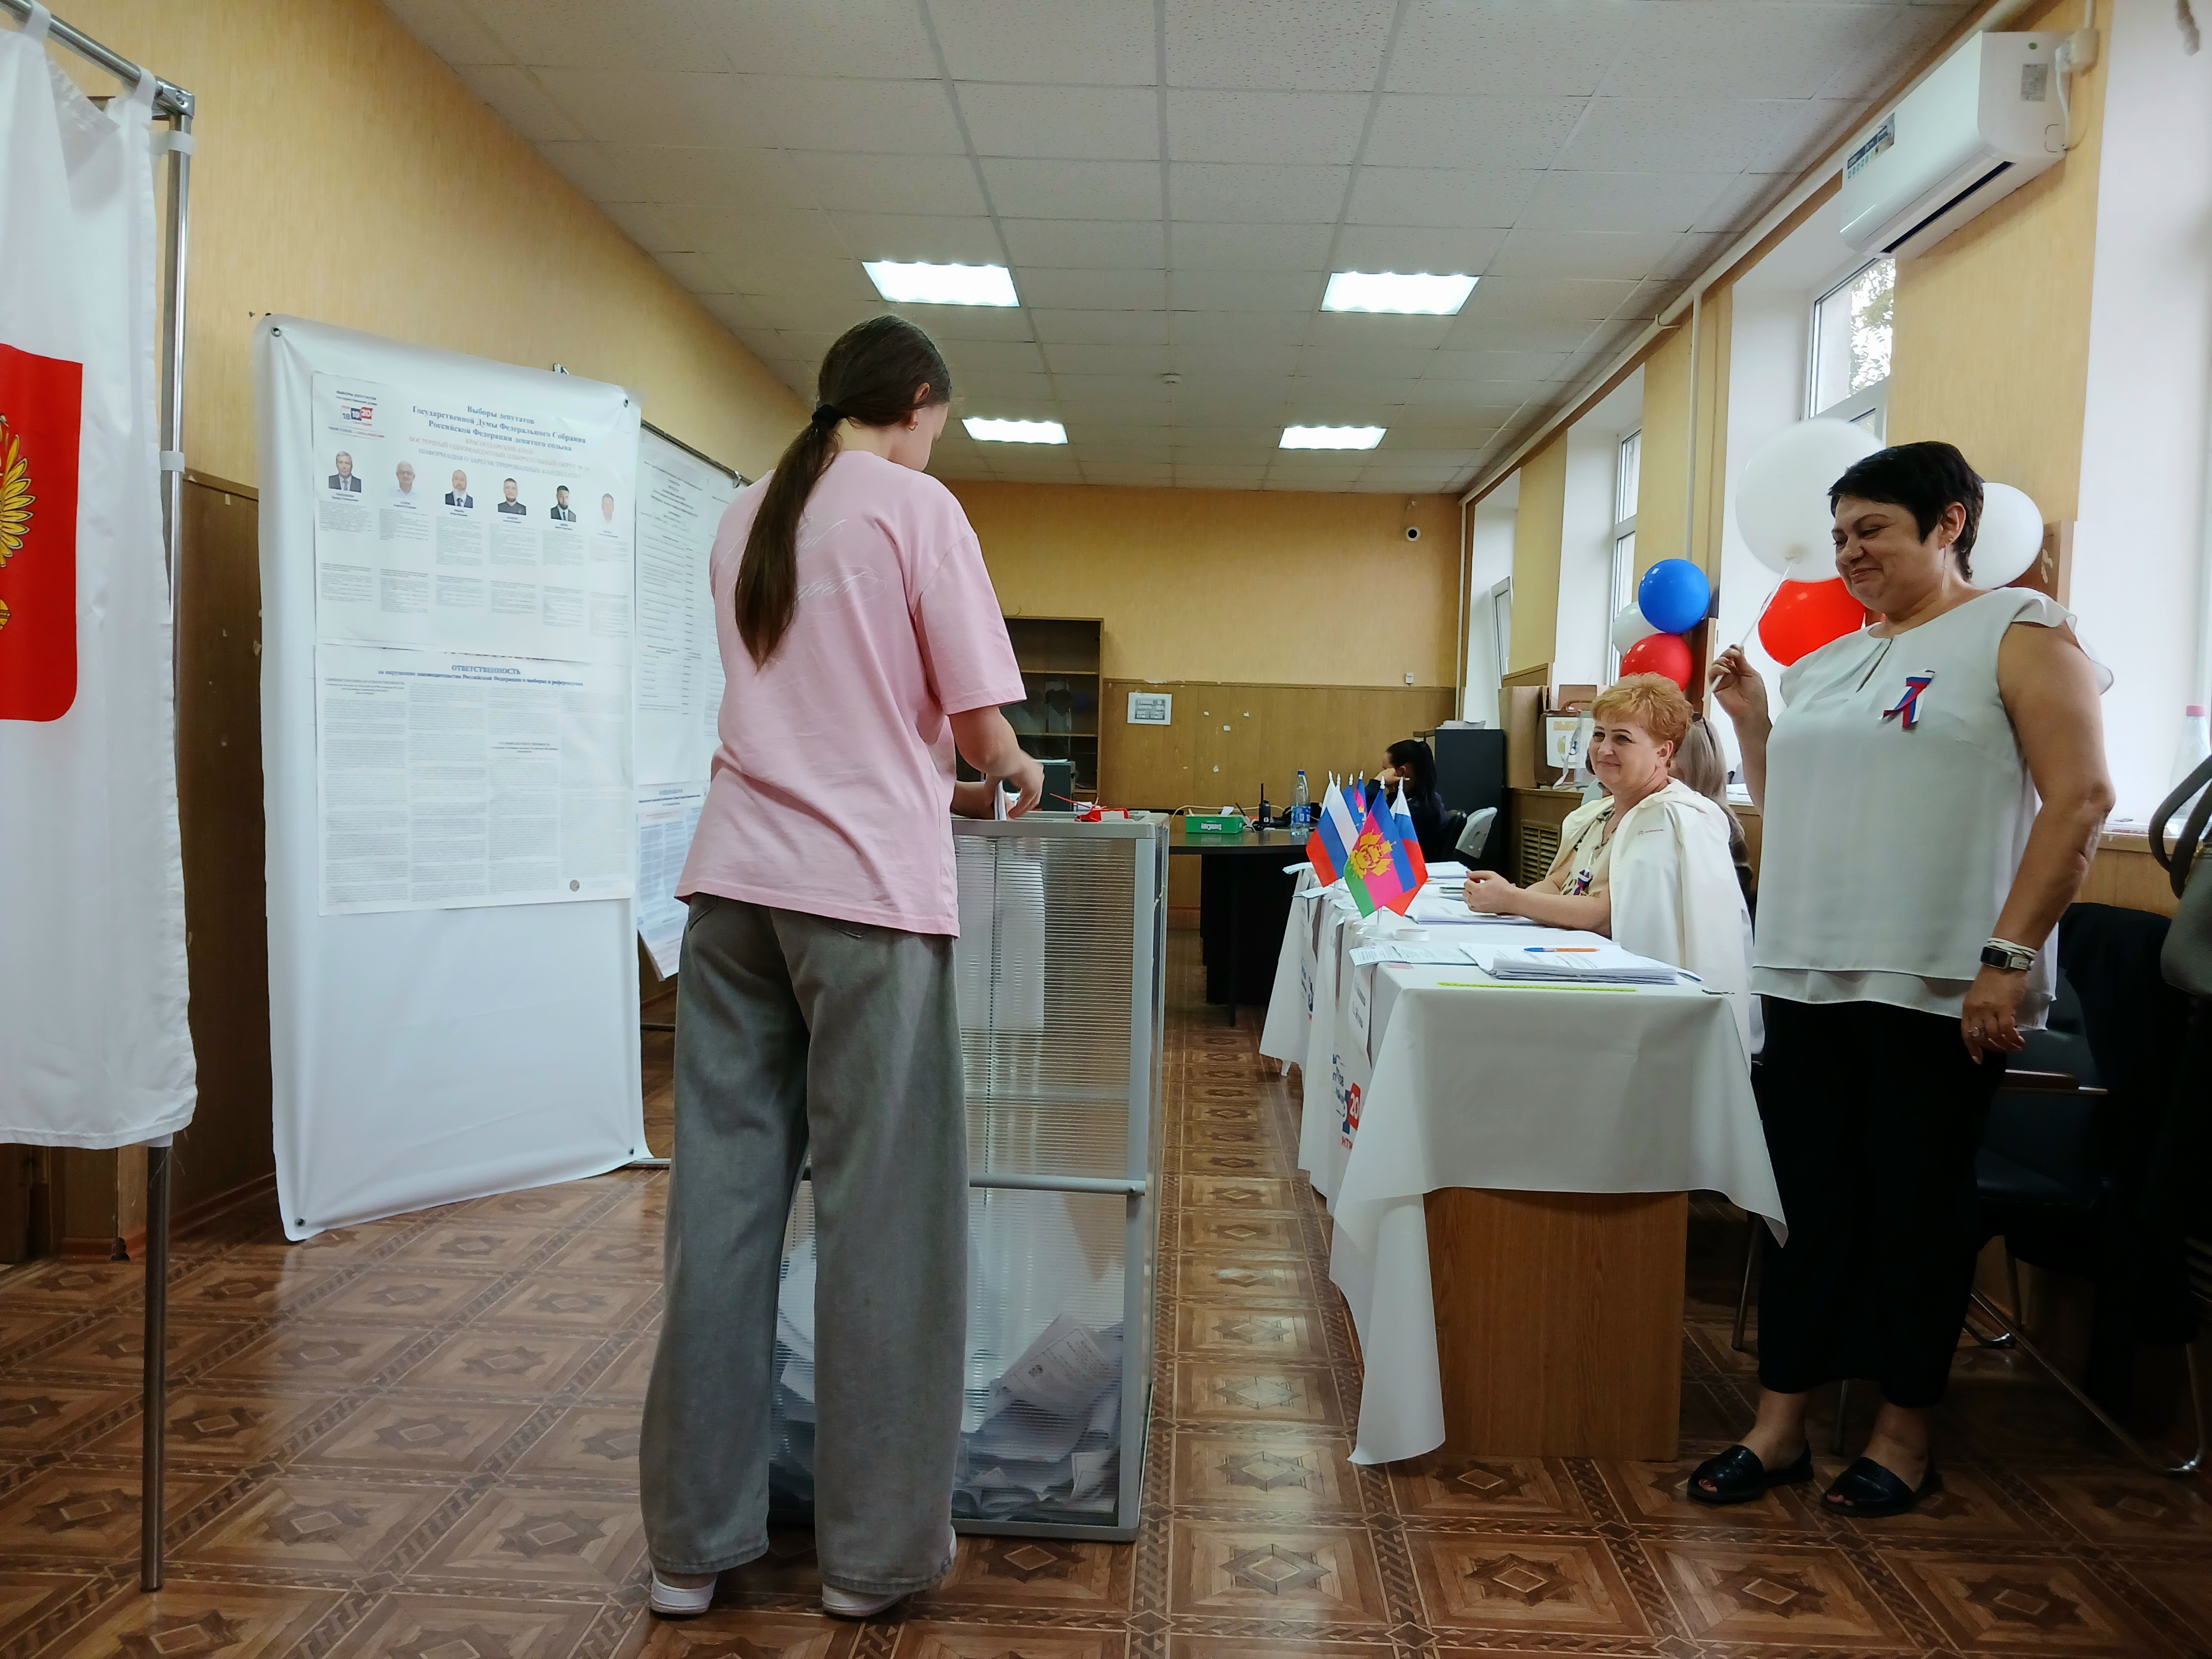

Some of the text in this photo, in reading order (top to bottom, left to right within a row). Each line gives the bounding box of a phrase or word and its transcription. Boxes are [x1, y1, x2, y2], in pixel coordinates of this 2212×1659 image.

[361, 409, 371, 417] 20
[413, 406, 586, 443] Государственной Думы Федерального Собрания
[467, 406, 535, 425] Выборы депутатов
[428, 420, 572, 452] Российской Федерации девятого созыва
[452, 665, 521, 675] ОТВЕТСТВЕННОСТЬ
[1349, 1092, 1359, 1120] 20
